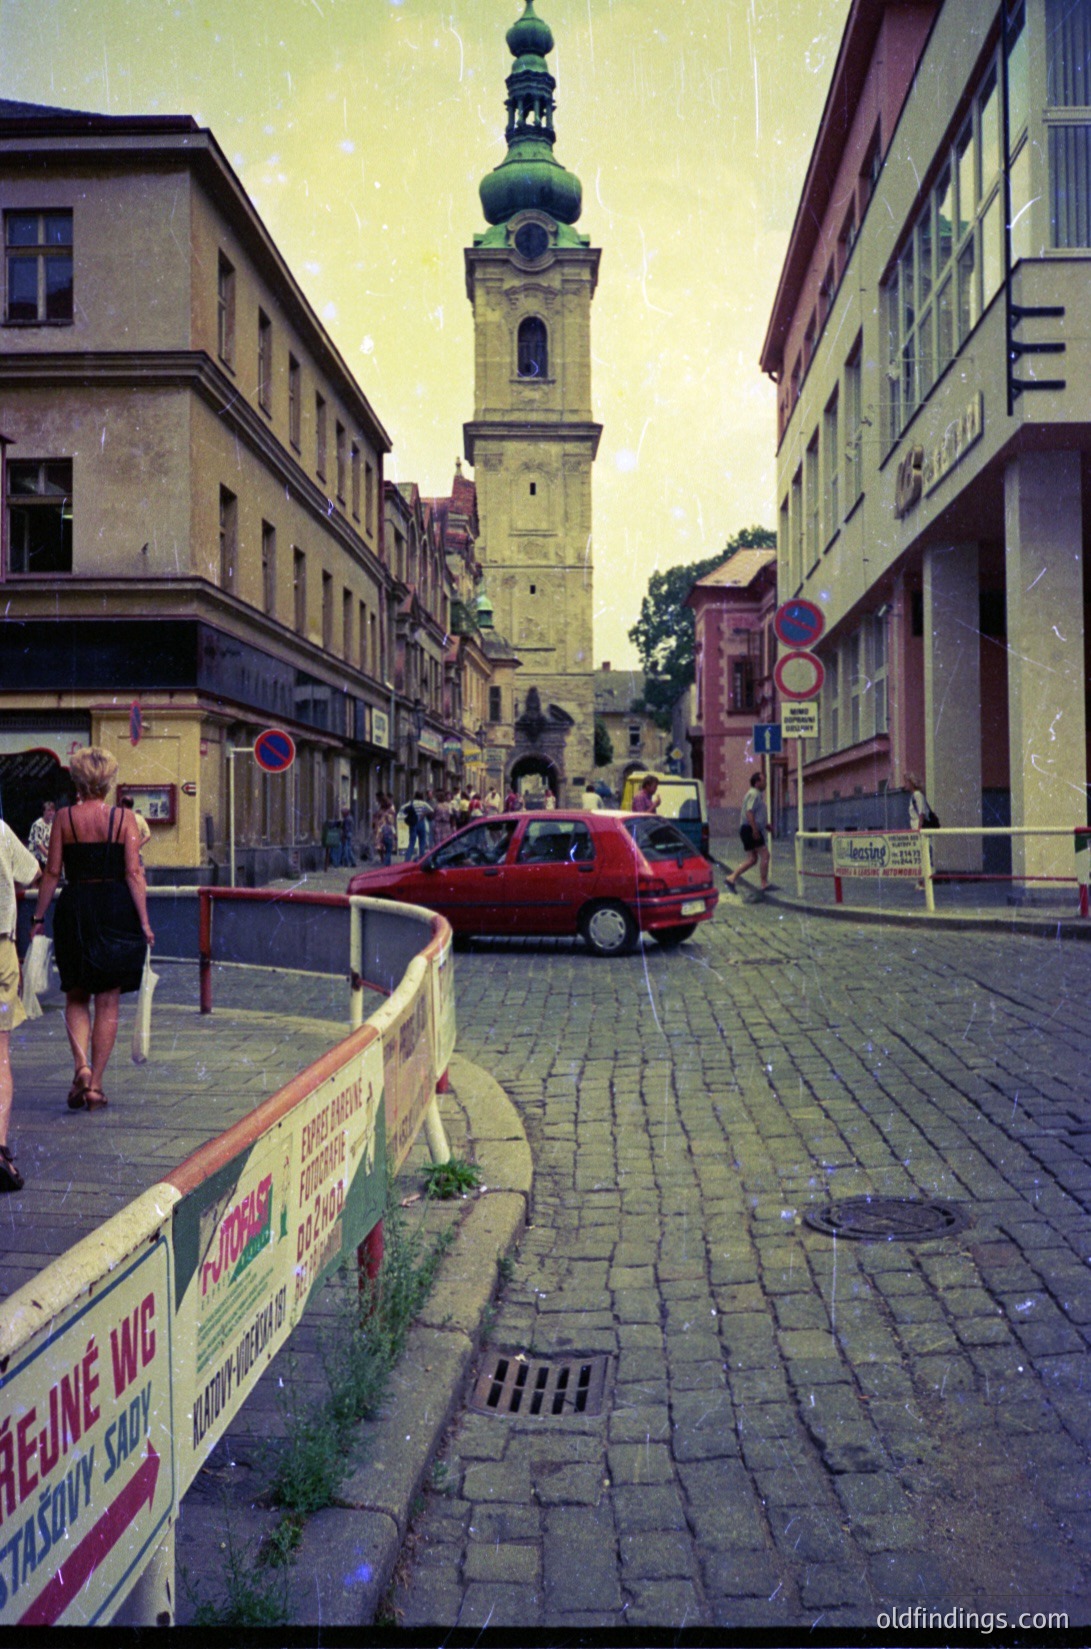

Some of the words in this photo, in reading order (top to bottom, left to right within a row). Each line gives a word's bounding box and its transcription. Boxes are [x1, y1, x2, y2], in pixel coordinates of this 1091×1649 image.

[849, 839, 886, 867] leasing
[299, 1131, 346, 1208] FOTOGRAFIE
[301, 1106, 329, 1164] EXPRES
[297, 1214, 312, 1263] DO
[313, 1194, 321, 1241] 2
[110, 1292, 156, 1398] WC
[104, 1381, 152, 1484] SADY
